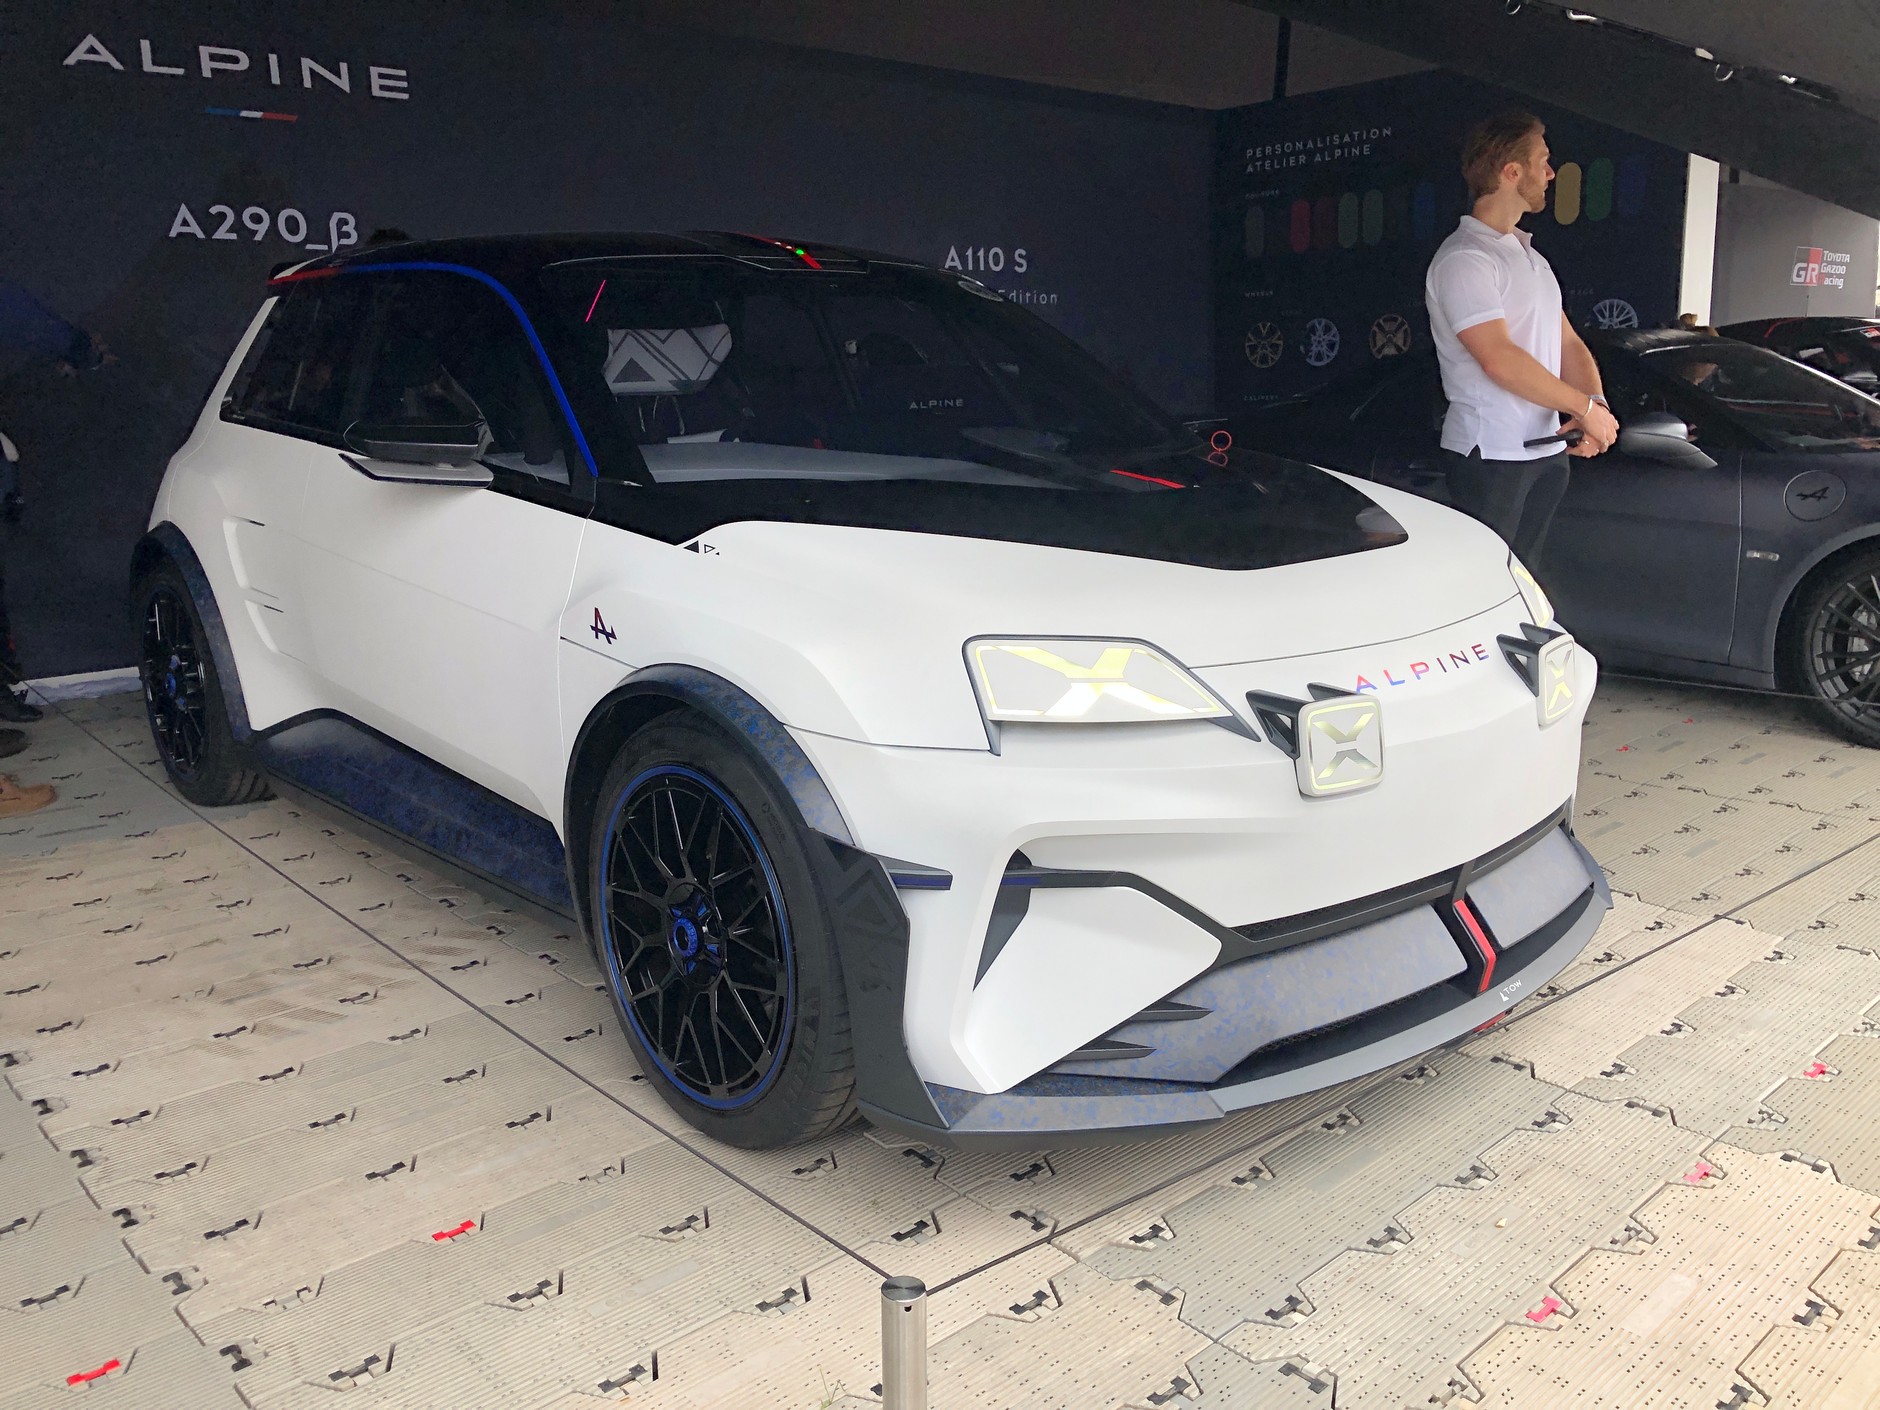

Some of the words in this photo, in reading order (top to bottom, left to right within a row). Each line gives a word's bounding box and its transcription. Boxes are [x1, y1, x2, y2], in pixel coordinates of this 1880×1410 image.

[62, 33, 410, 100] ALPINE
[1246, 127, 1392, 160] PERSONALISATION
[1245, 154, 1307, 174] ATELIER
[1314, 143, 1372, 162] ALPINE
[944, 245, 1005, 272] A110
[1014, 248, 1028, 274] S
[1820, 262, 1846, 275] GAZOO
[1823, 250, 1850, 263] TOYOTA
[1792, 262, 1819, 284] GR
[908, 398, 964, 410] ALPINE
[1355, 643, 1490, 695] ALPINE
[1503, 979, 1522, 995] TOW
